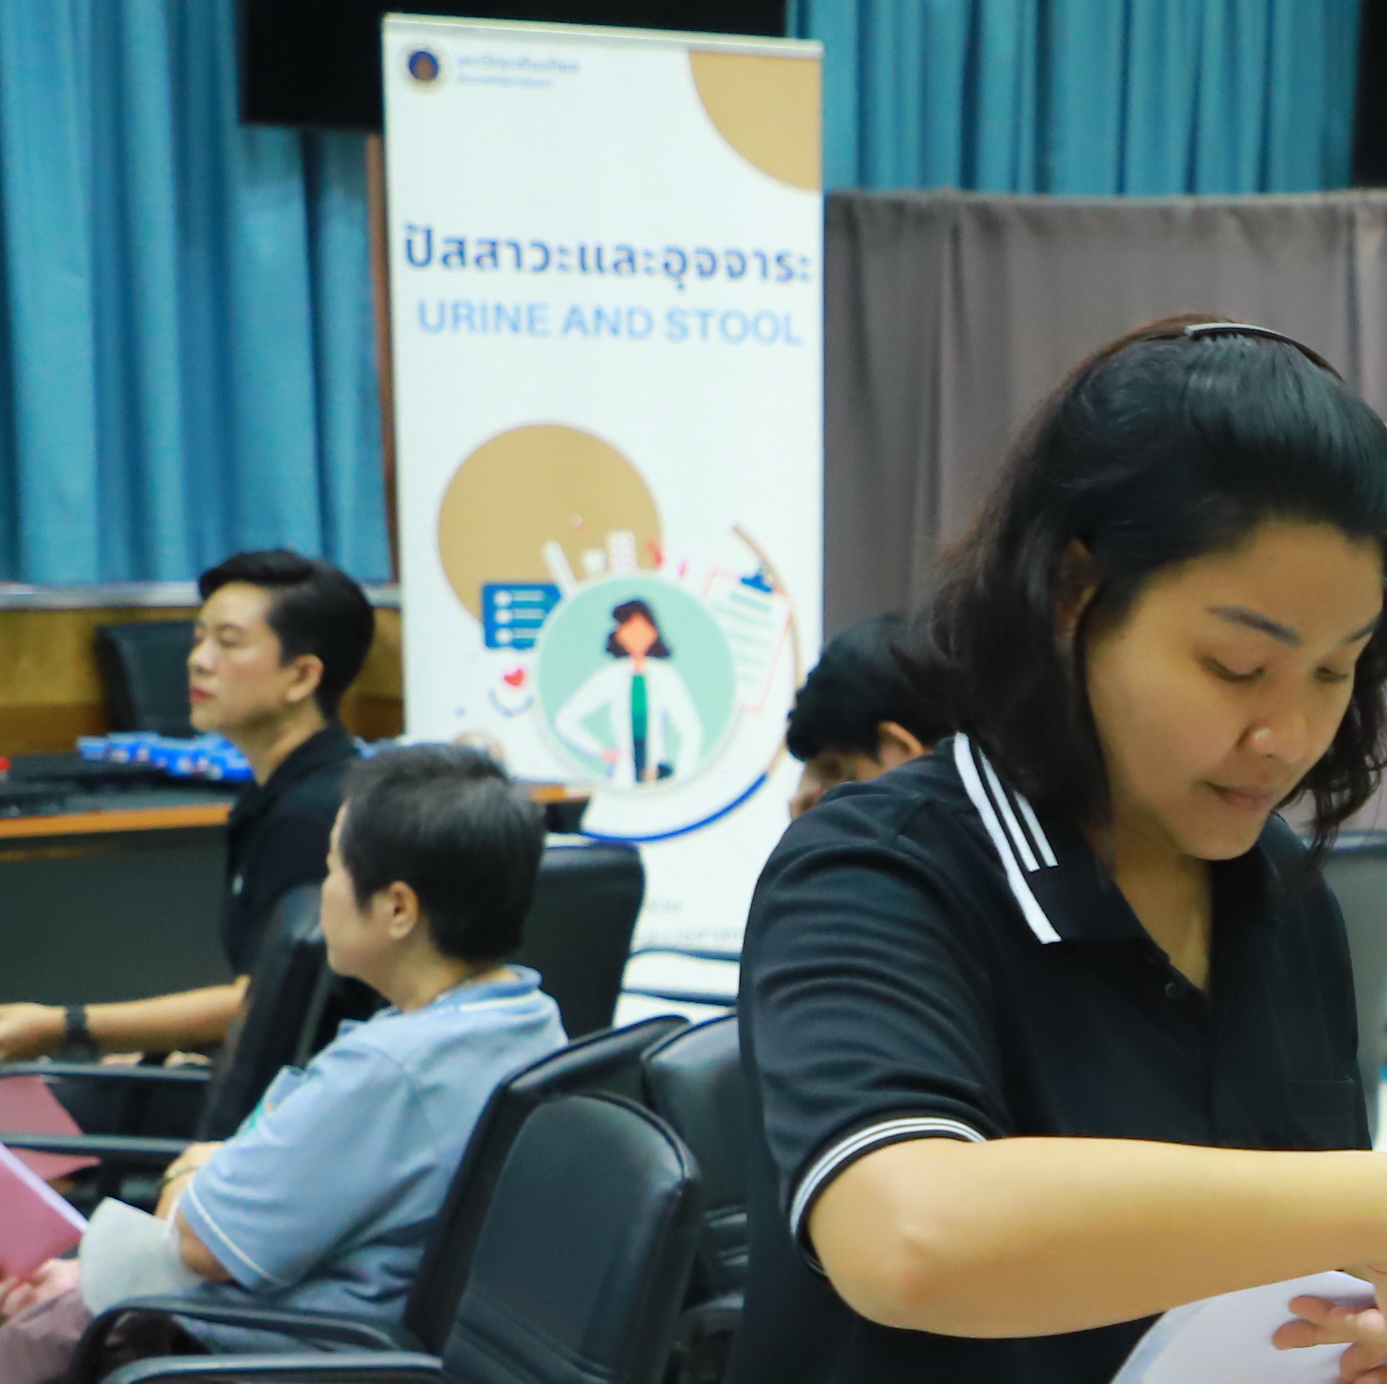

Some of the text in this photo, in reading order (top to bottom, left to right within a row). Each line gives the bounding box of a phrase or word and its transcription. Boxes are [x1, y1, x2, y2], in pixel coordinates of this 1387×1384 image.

[404, 222, 813, 293] ปัสสาวะและอุจจาระ
[417, 297, 806, 347] URINE AND STOOL
